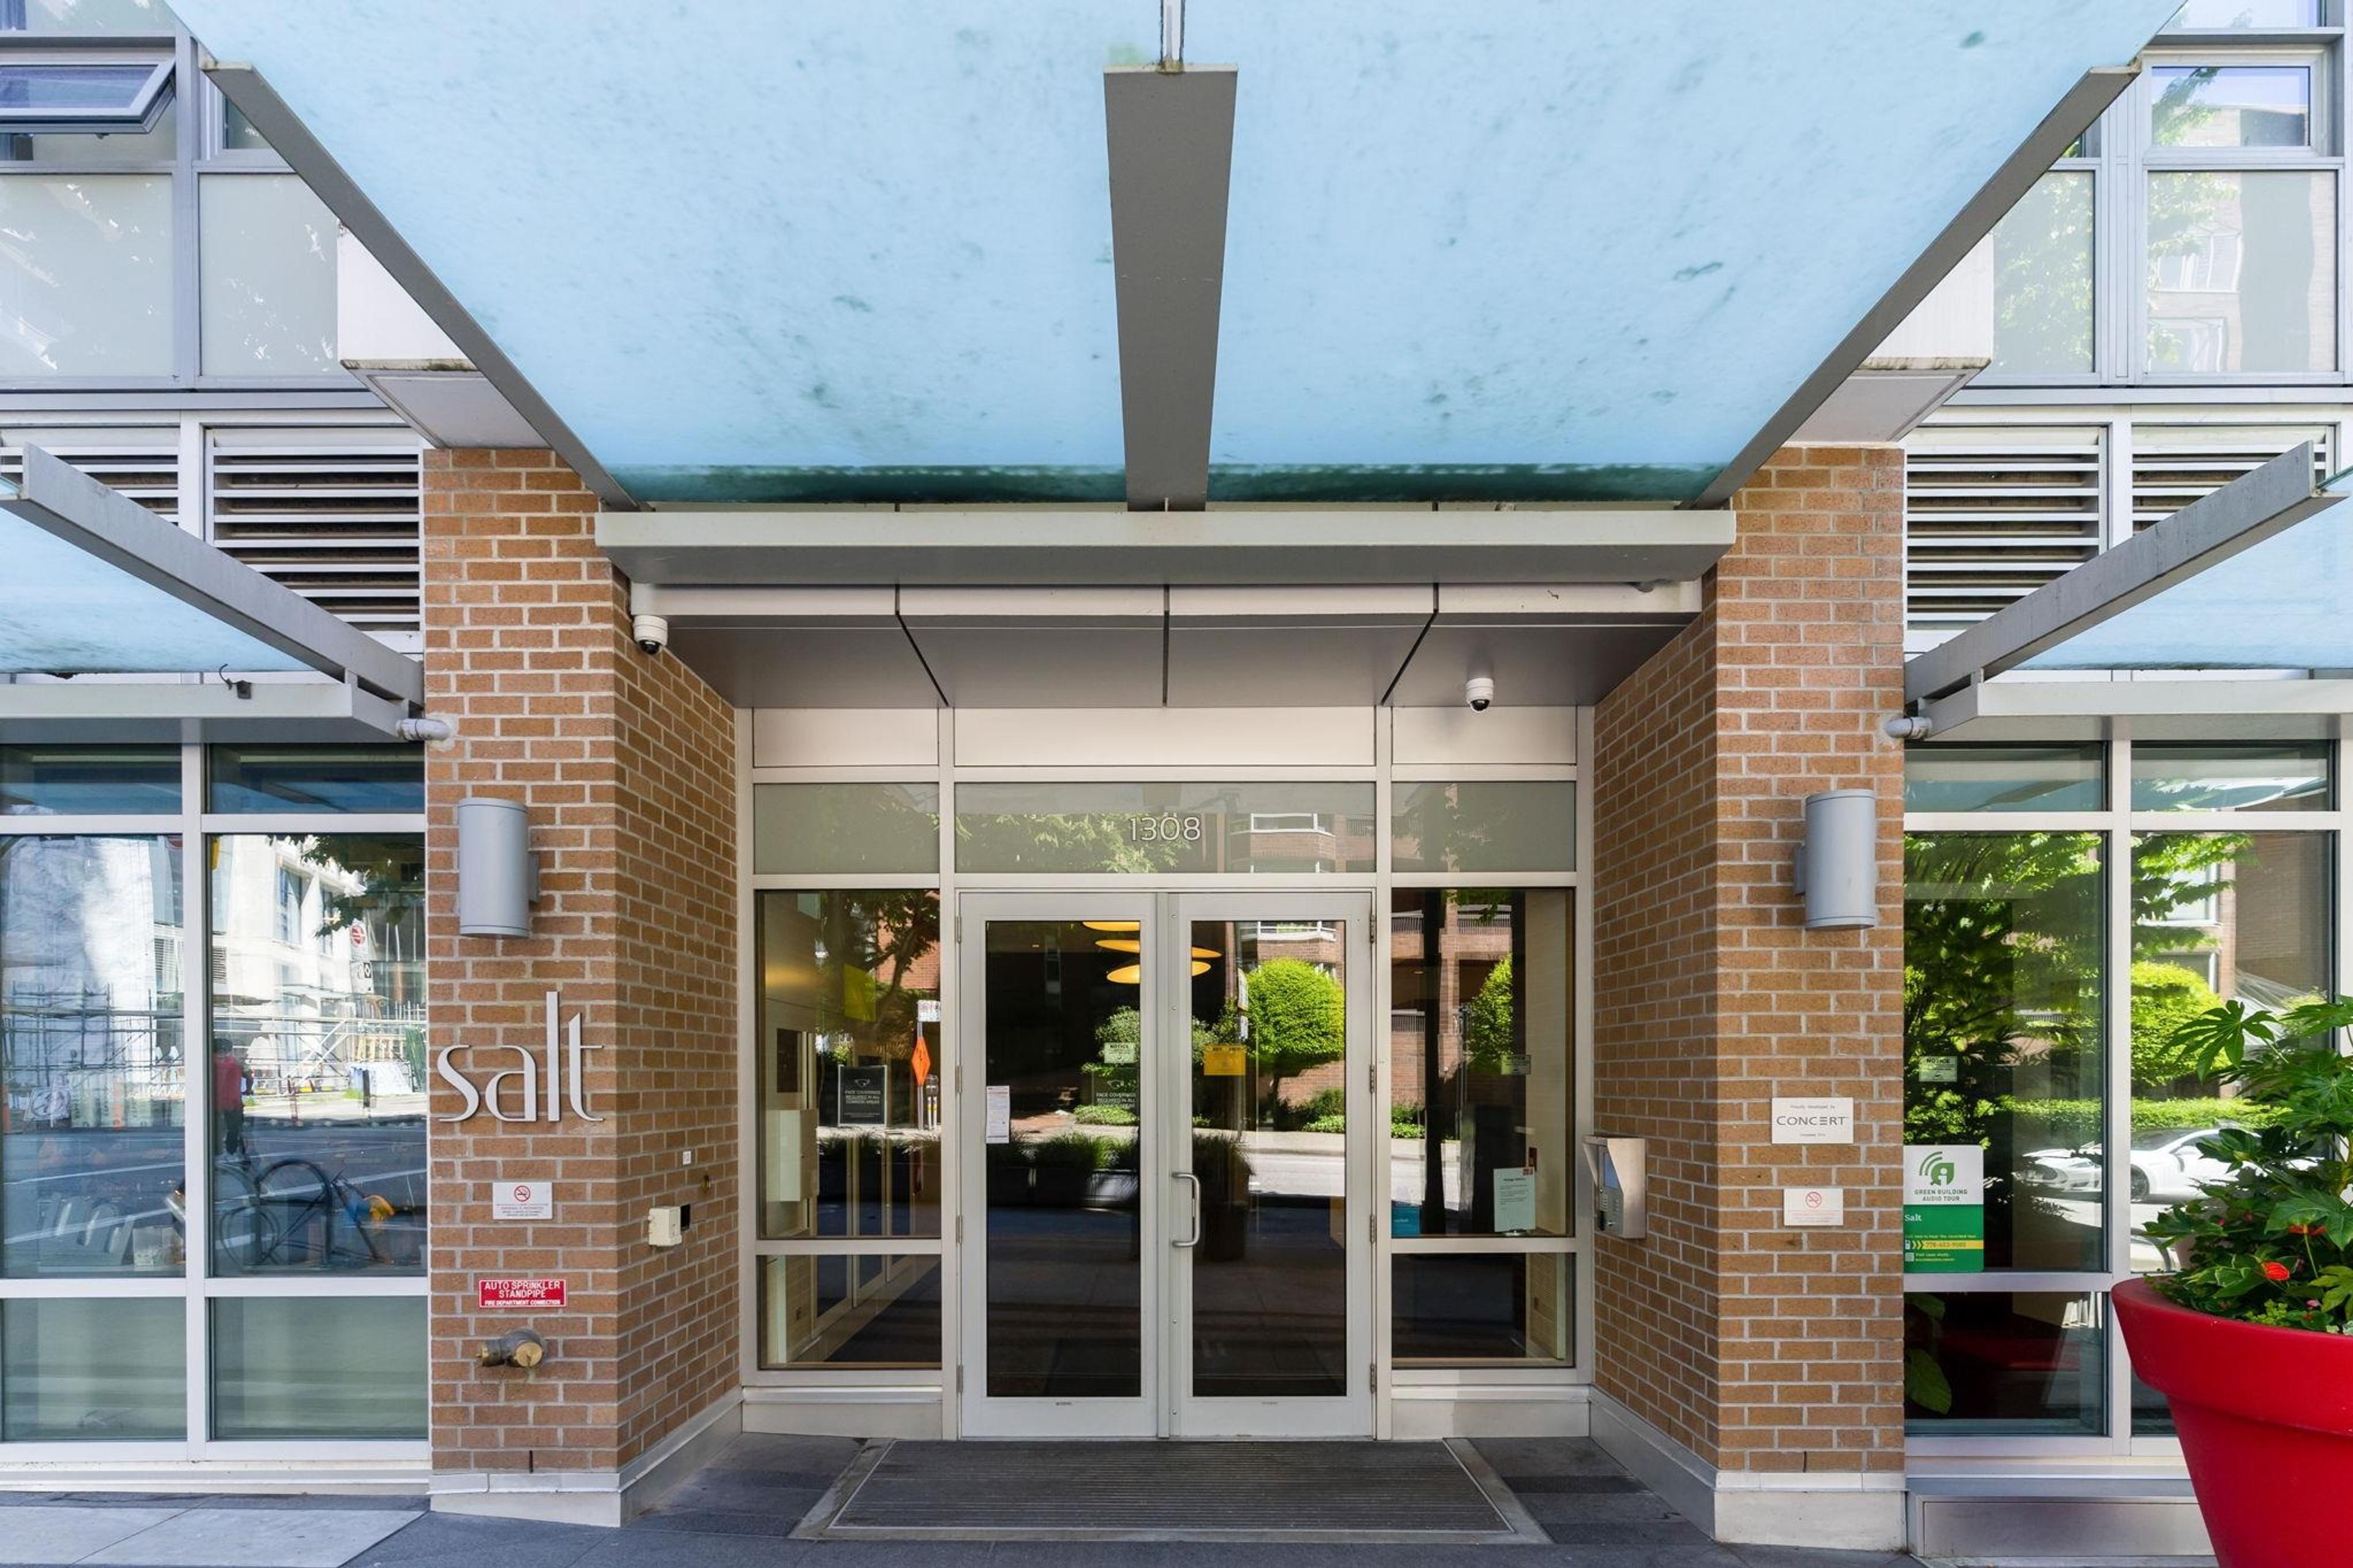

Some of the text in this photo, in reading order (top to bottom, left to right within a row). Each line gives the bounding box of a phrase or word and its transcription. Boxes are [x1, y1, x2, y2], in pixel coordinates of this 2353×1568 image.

[1130, 816, 1201, 841] 1308
[437, 991, 605, 1122] salt
[1776, 1115, 1849, 1126] CONCERT
[1904, 1213, 1922, 1222] Salt
[485, 1281, 561, 1290] AUTO SPRINKLER
[499, 1289, 546, 1298] STANDPIPE
